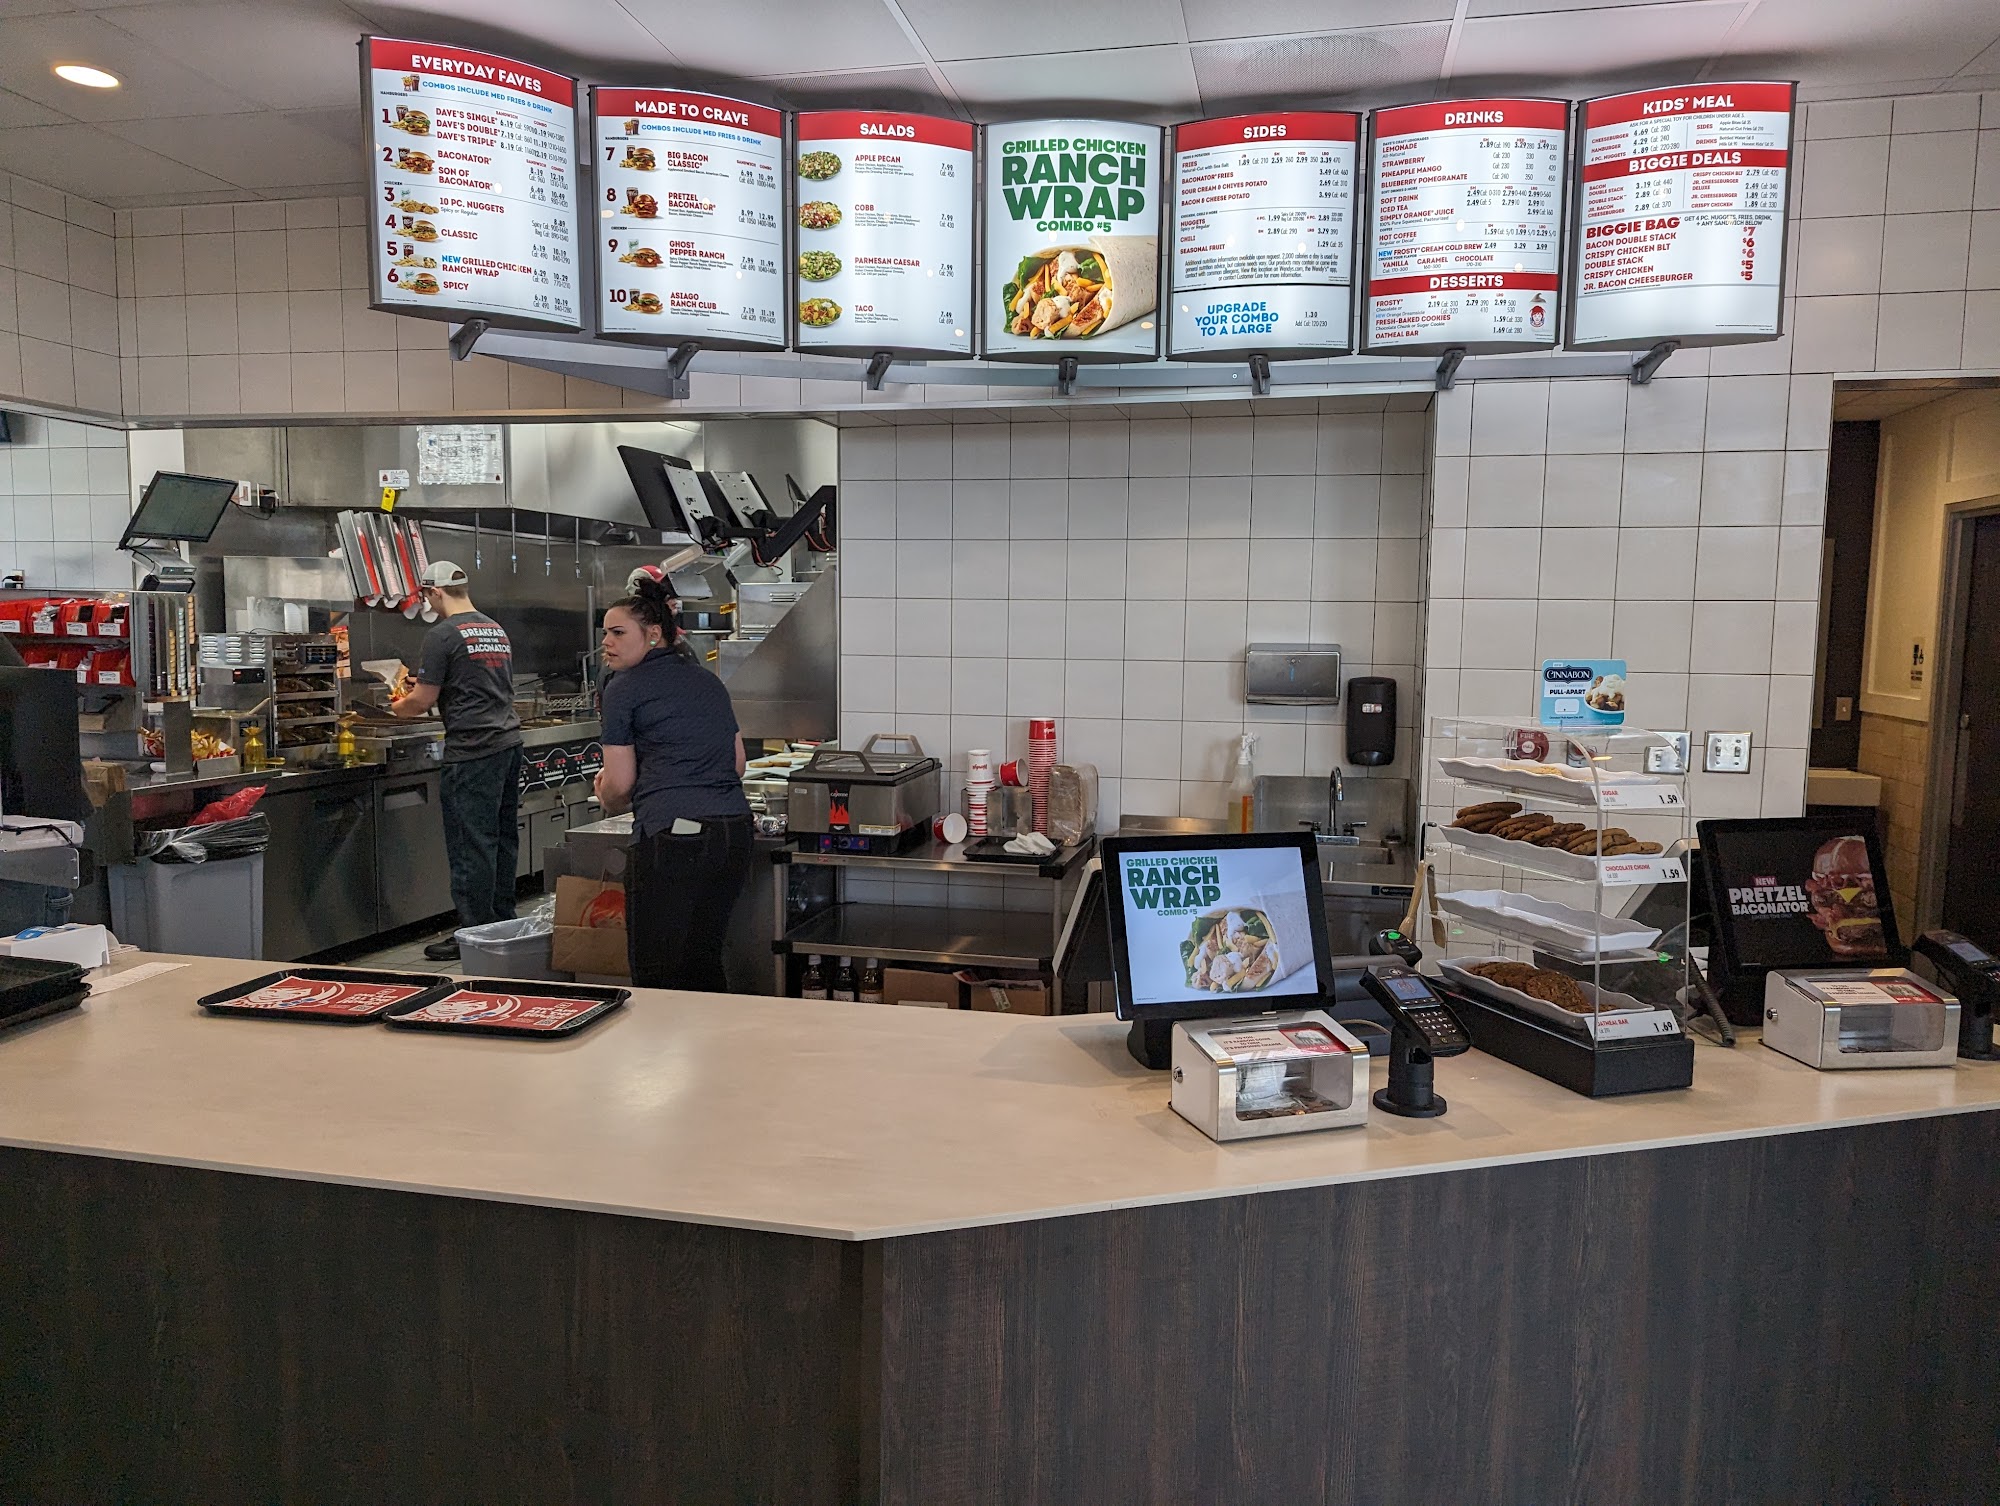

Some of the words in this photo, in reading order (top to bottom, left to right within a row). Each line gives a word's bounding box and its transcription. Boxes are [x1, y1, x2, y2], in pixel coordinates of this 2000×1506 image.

[411, 54, 496, 80] EVERYDAY
[498, 69, 542, 93] FAVES
[422, 81, 456, 91] COMBOS
[457, 86, 490, 97] INCLUDE
[491, 92, 506, 101] MED
[507, 96, 526, 106] FRIES
[532, 103, 553, 114] DRINK
[1643, 97, 1690, 114] KIDS'
[1692, 95, 1735, 109] MEAL
[382, 108, 391, 124] 1
[635, 100, 676, 115] MADE
[679, 103, 699, 117] TO
[702, 106, 749, 126] CRAVE
[1444, 111, 1504, 126] DRINKS
[860, 122, 915, 138] SALADS
[1243, 125, 1287, 139] SIDES
[605, 146, 615, 161] 7
[1002, 139, 1069, 155] GRILLED
[1072, 138, 1146, 156] CHICKEN
[1382, 143, 1418, 153] LEMONADE
[383, 147, 393, 162] 2
[667, 151, 681, 160] BIG
[683, 153, 709, 163] BACON
[855, 154, 876, 163] APPLE
[878, 155, 901, 163] PECAN
[1182, 160, 1198, 169] FRIES
[1382, 156, 1426, 168] STRAWBERRY
[1629, 153, 1688, 173] BIGGIE
[1692, 151, 1742, 167] DEALS
[438, 166, 457, 176] SON
[458, 169, 470, 178] OF
[1002, 153, 1146, 188] RANCH
[1381, 168, 1416, 179] PINEAPPLE
[1416, 165, 1442, 174] MANGO
[1181, 186, 1197, 196] SOUR
[1197, 184, 1217, 194] CREAM
[1222, 181, 1244, 190] CHIVES
[1245, 180, 1268, 188] POTATO
[1381, 177, 1418, 189] BLUEBERRY
[1418, 173, 1468, 185] POMEGRANATE
[384, 186, 395, 202] 3
[606, 187, 616, 202] 8
[668, 191, 699, 202] PRETZEL
[1380, 196, 1397, 205] SOFT
[1398, 194, 1419, 202] DRINK
[440, 197, 449, 206] 10
[467, 201, 505, 214] NUGGETS
[1002, 185, 1146, 222] WRAP
[1380, 205, 1395, 214] ICED
[1396, 204, 1409, 212] TEA
[385, 214, 396, 229] 4
[1036, 220, 1094, 233] COMBO
[1097, 221, 1112, 233] #5
[441, 228, 478, 240] CLASSIC
[1379, 234, 1392, 242] HOT
[1393, 231, 1417, 240] COFFEE
[1585, 239, 1614, 250] BACON
[1616, 235, 1648, 247] DOUBLE
[1649, 232, 1677, 242] STACK
[387, 241, 398, 256] 5
[608, 238, 618, 253] 9
[669, 240, 695, 249] GHOST
[1180, 246, 1208, 254] SEASONAL
[1209, 243, 1226, 251] FRUIT
[1585, 249, 1615, 260] CRISPY
[1616, 245, 1655, 257] CHICKEN
[1657, 243, 1671, 252] BLT
[669, 248, 697, 258] PEPPER
[699, 250, 725, 260] RANCH
[1416, 256, 1449, 266] CARAMEL
[1454, 254, 1494, 263] CHOCOLATE
[441, 255, 462, 264] NEW
[462, 257, 496, 269] GRILLED
[496, 261, 532, 275] CHICKEN
[854, 256, 892, 266] PARMESAN
[893, 257, 921, 267] CAESAR
[1382, 259, 1409, 268] VANILLA
[1584, 259, 1616, 271] DOUBLE
[1616, 256, 1644, 266] STACK
[387, 268, 399, 283] 6
[442, 264, 473, 275] RANCH
[474, 267, 500, 278] WRAP
[1583, 270, 1614, 281] CRISPY
[1615, 265, 1654, 277] CHICKEN
[443, 281, 470, 291] SPICY
[1430, 274, 1504, 289] DESSERTS
[1597, 279, 1627, 290] BACON
[1628, 273, 1694, 286] CHEESEBURGER
[609, 289, 627, 303] 10
[670, 291, 699, 301] ASIAGO
[670, 299, 697, 309] RANCH
[698, 301, 718, 310] CLUB
[855, 304, 873, 312] TACO
[1207, 301, 1267, 315] UPGRADE
[1195, 314, 1228, 327] YOUR
[1231, 312, 1279, 324] COMBO
[1375, 315, 1420, 326] FRESH-BAKED
[1420, 314, 1451, 322] COOKIES
[1200, 326, 1216, 337] TO
[1219, 325, 1229, 336] A
[1231, 323, 1272, 335] LARGE
[1375, 330, 1405, 339] OATMEAL
[1405, 330, 1419, 338] BAR
[1546, 669, 1591, 679] CINNABON
[1659, 794, 1678, 804] 1.59
[1126, 857, 1169, 868] GRILLED
[1170, 855, 1218, 866] CHICKEN
[1605, 864, 1633, 872] CHOCOLATE
[1126, 865, 1220, 888] RANCH
[1661, 868, 1680, 879] 1.59
[1755, 877, 1775, 886] NEW
[1128, 885, 1221, 910] WRAP
[1728, 885, 1807, 904] PRETZEL
[1157, 908, 1188, 917] COMBO
[1653, 1021, 1673, 1033] 1.69
